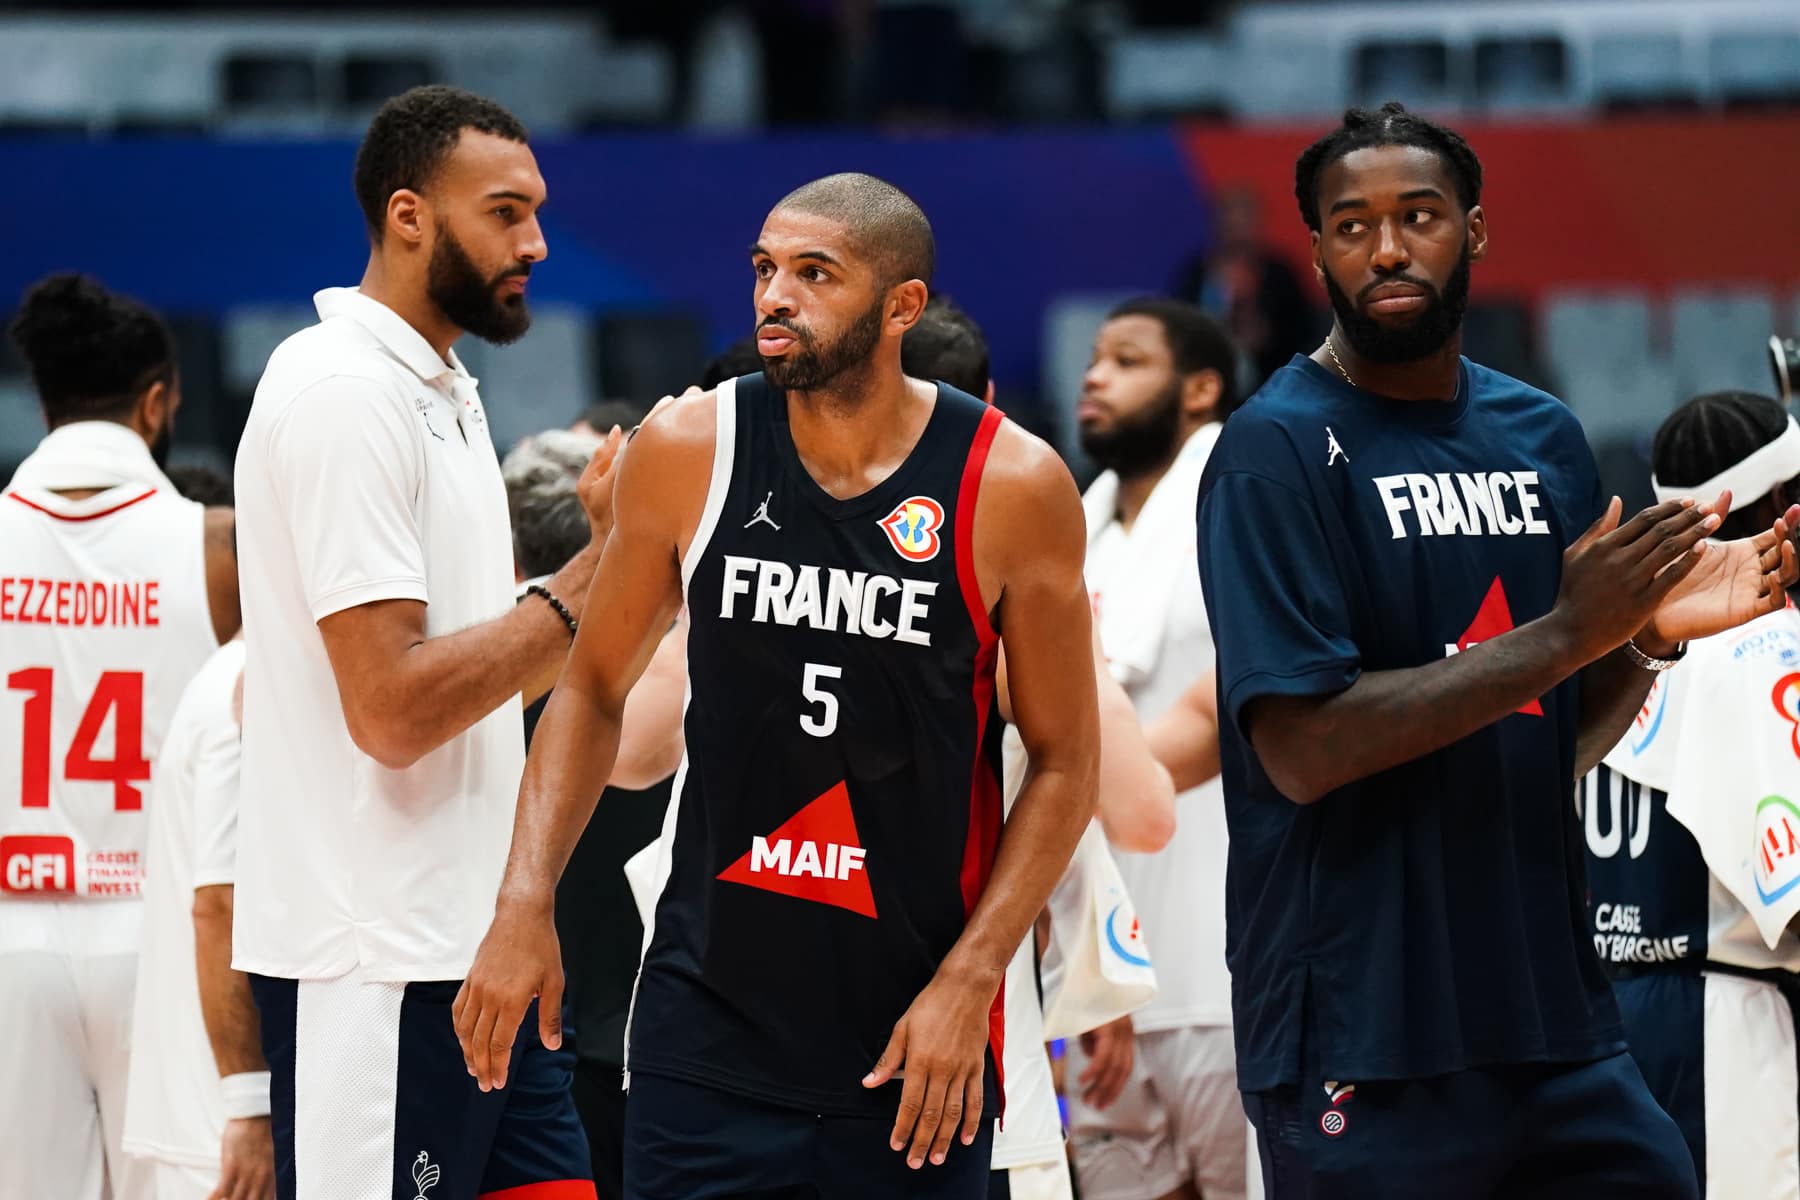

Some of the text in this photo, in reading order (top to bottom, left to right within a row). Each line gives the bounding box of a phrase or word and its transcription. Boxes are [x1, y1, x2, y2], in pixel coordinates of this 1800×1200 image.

[1372, 471, 1550, 539] FRANCE
[1, 577, 160, 627] EZZEDDINE
[719, 554, 940, 647] FRANCE
[800, 662, 842, 738] 5
[7, 667, 151, 812] 14
[6, 853, 67, 890] CFI
[750, 835, 867, 881] MAIF
